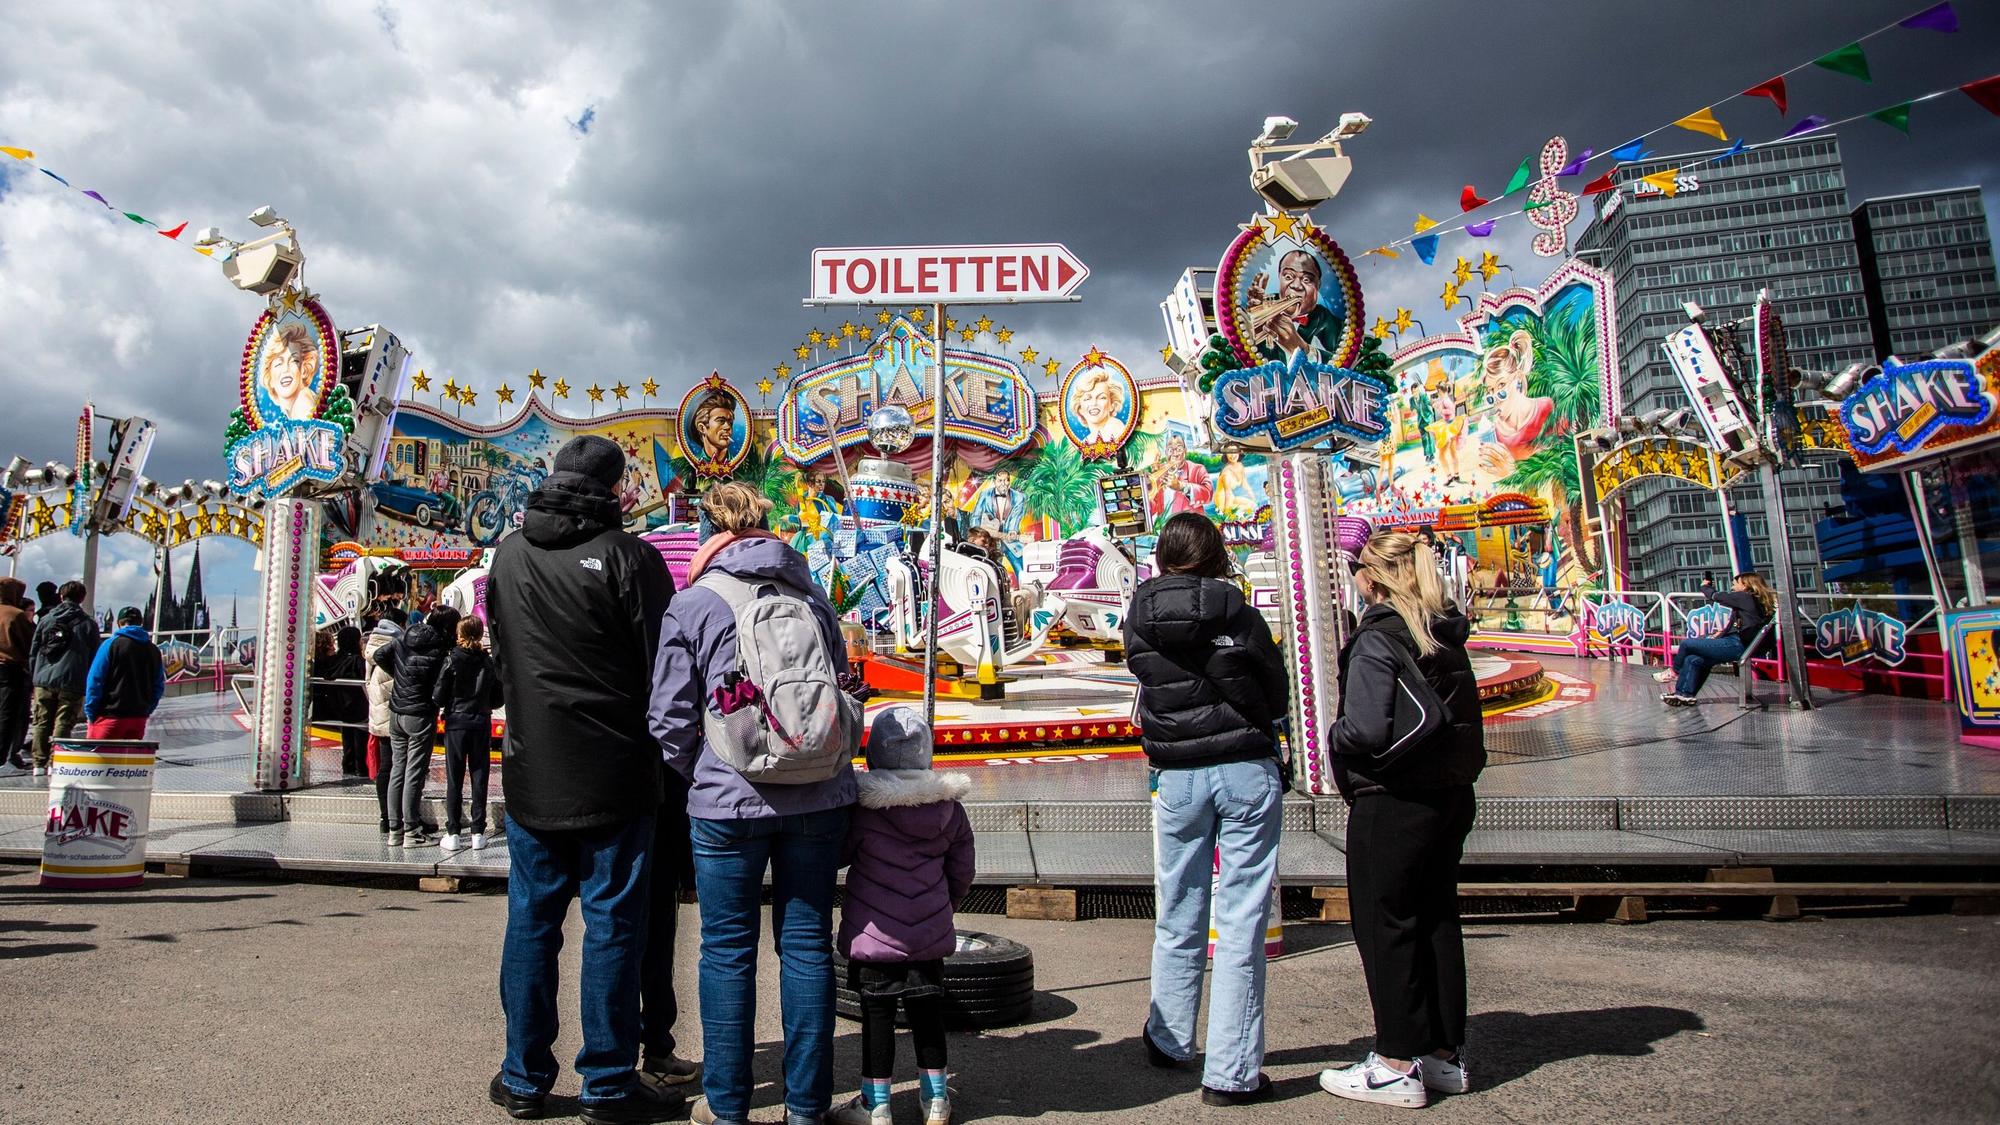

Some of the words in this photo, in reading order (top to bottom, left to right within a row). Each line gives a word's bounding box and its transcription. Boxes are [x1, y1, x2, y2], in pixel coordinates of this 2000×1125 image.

[821, 255, 1049, 295] TOILETTEN
[806, 362, 1007, 433] SHAKE
[1222, 367, 1384, 431] SHAKE
[1851, 369, 1982, 443] SHAKE
[233, 425, 336, 486] SHAKE
[1598, 607, 1641, 636] SHAKE
[1689, 610, 1730, 638] SHA
[1820, 614, 1900, 656] SHAKE
[160, 646, 198, 669] HAKE
[59, 766, 104, 777] Sauberer
[105, 767, 149, 779] Festplatz
[984, 754, 1109, 765] STOP
[47, 804, 129, 841] HAKE
